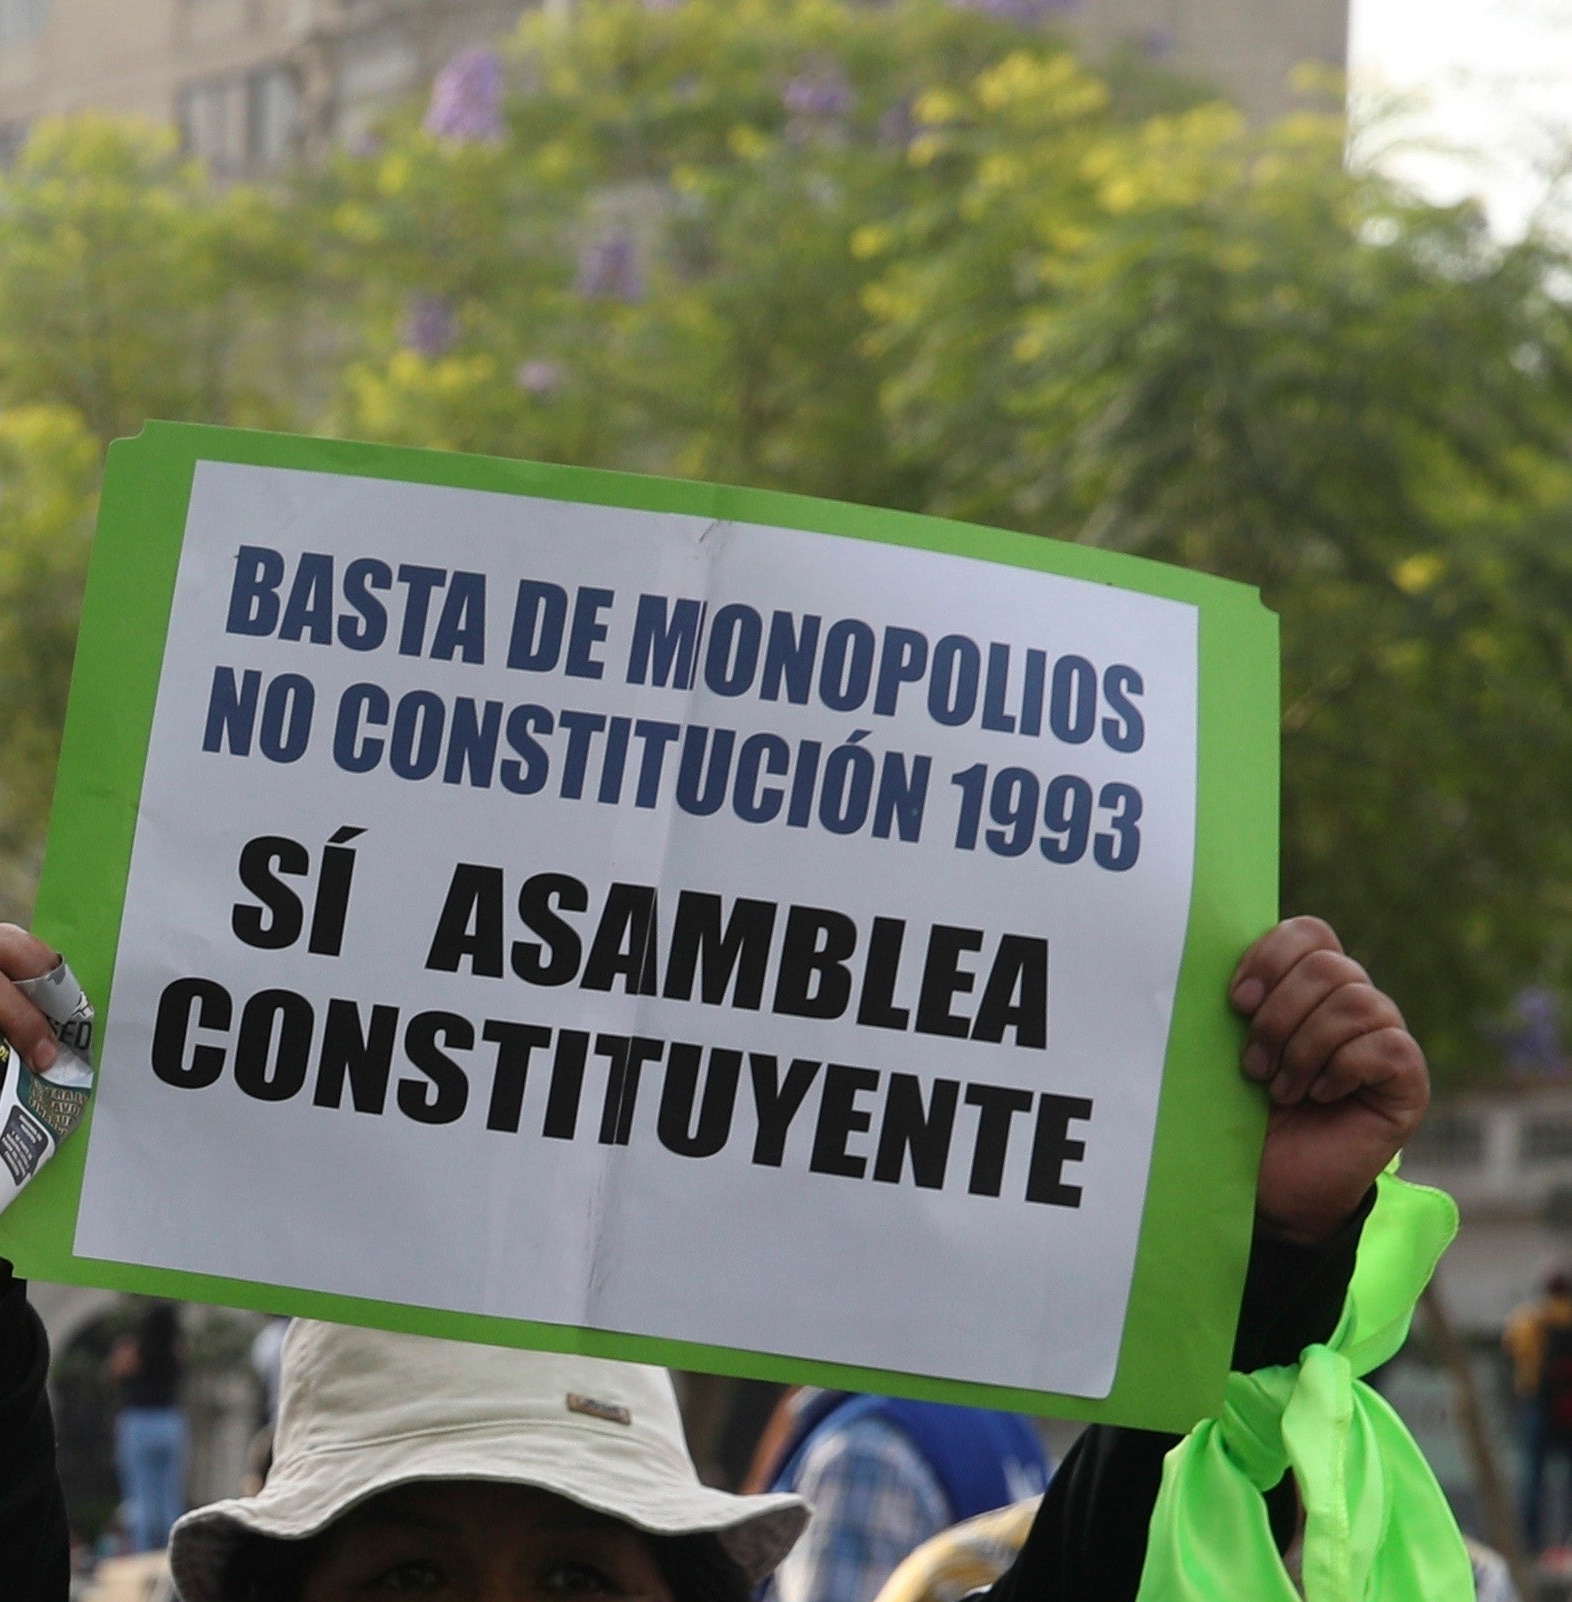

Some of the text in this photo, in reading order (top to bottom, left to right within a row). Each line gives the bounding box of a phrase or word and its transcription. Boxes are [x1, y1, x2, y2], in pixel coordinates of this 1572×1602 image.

[225, 545, 1146, 753] BASTA DE MONOPOLIOS
[201, 665, 1143, 872] NO CONSTITUCIÓN 1993
[231, 825, 1050, 1051] SÍ ASAMBLEA
[150, 976, 1094, 1210] CONSTITUYENTE
